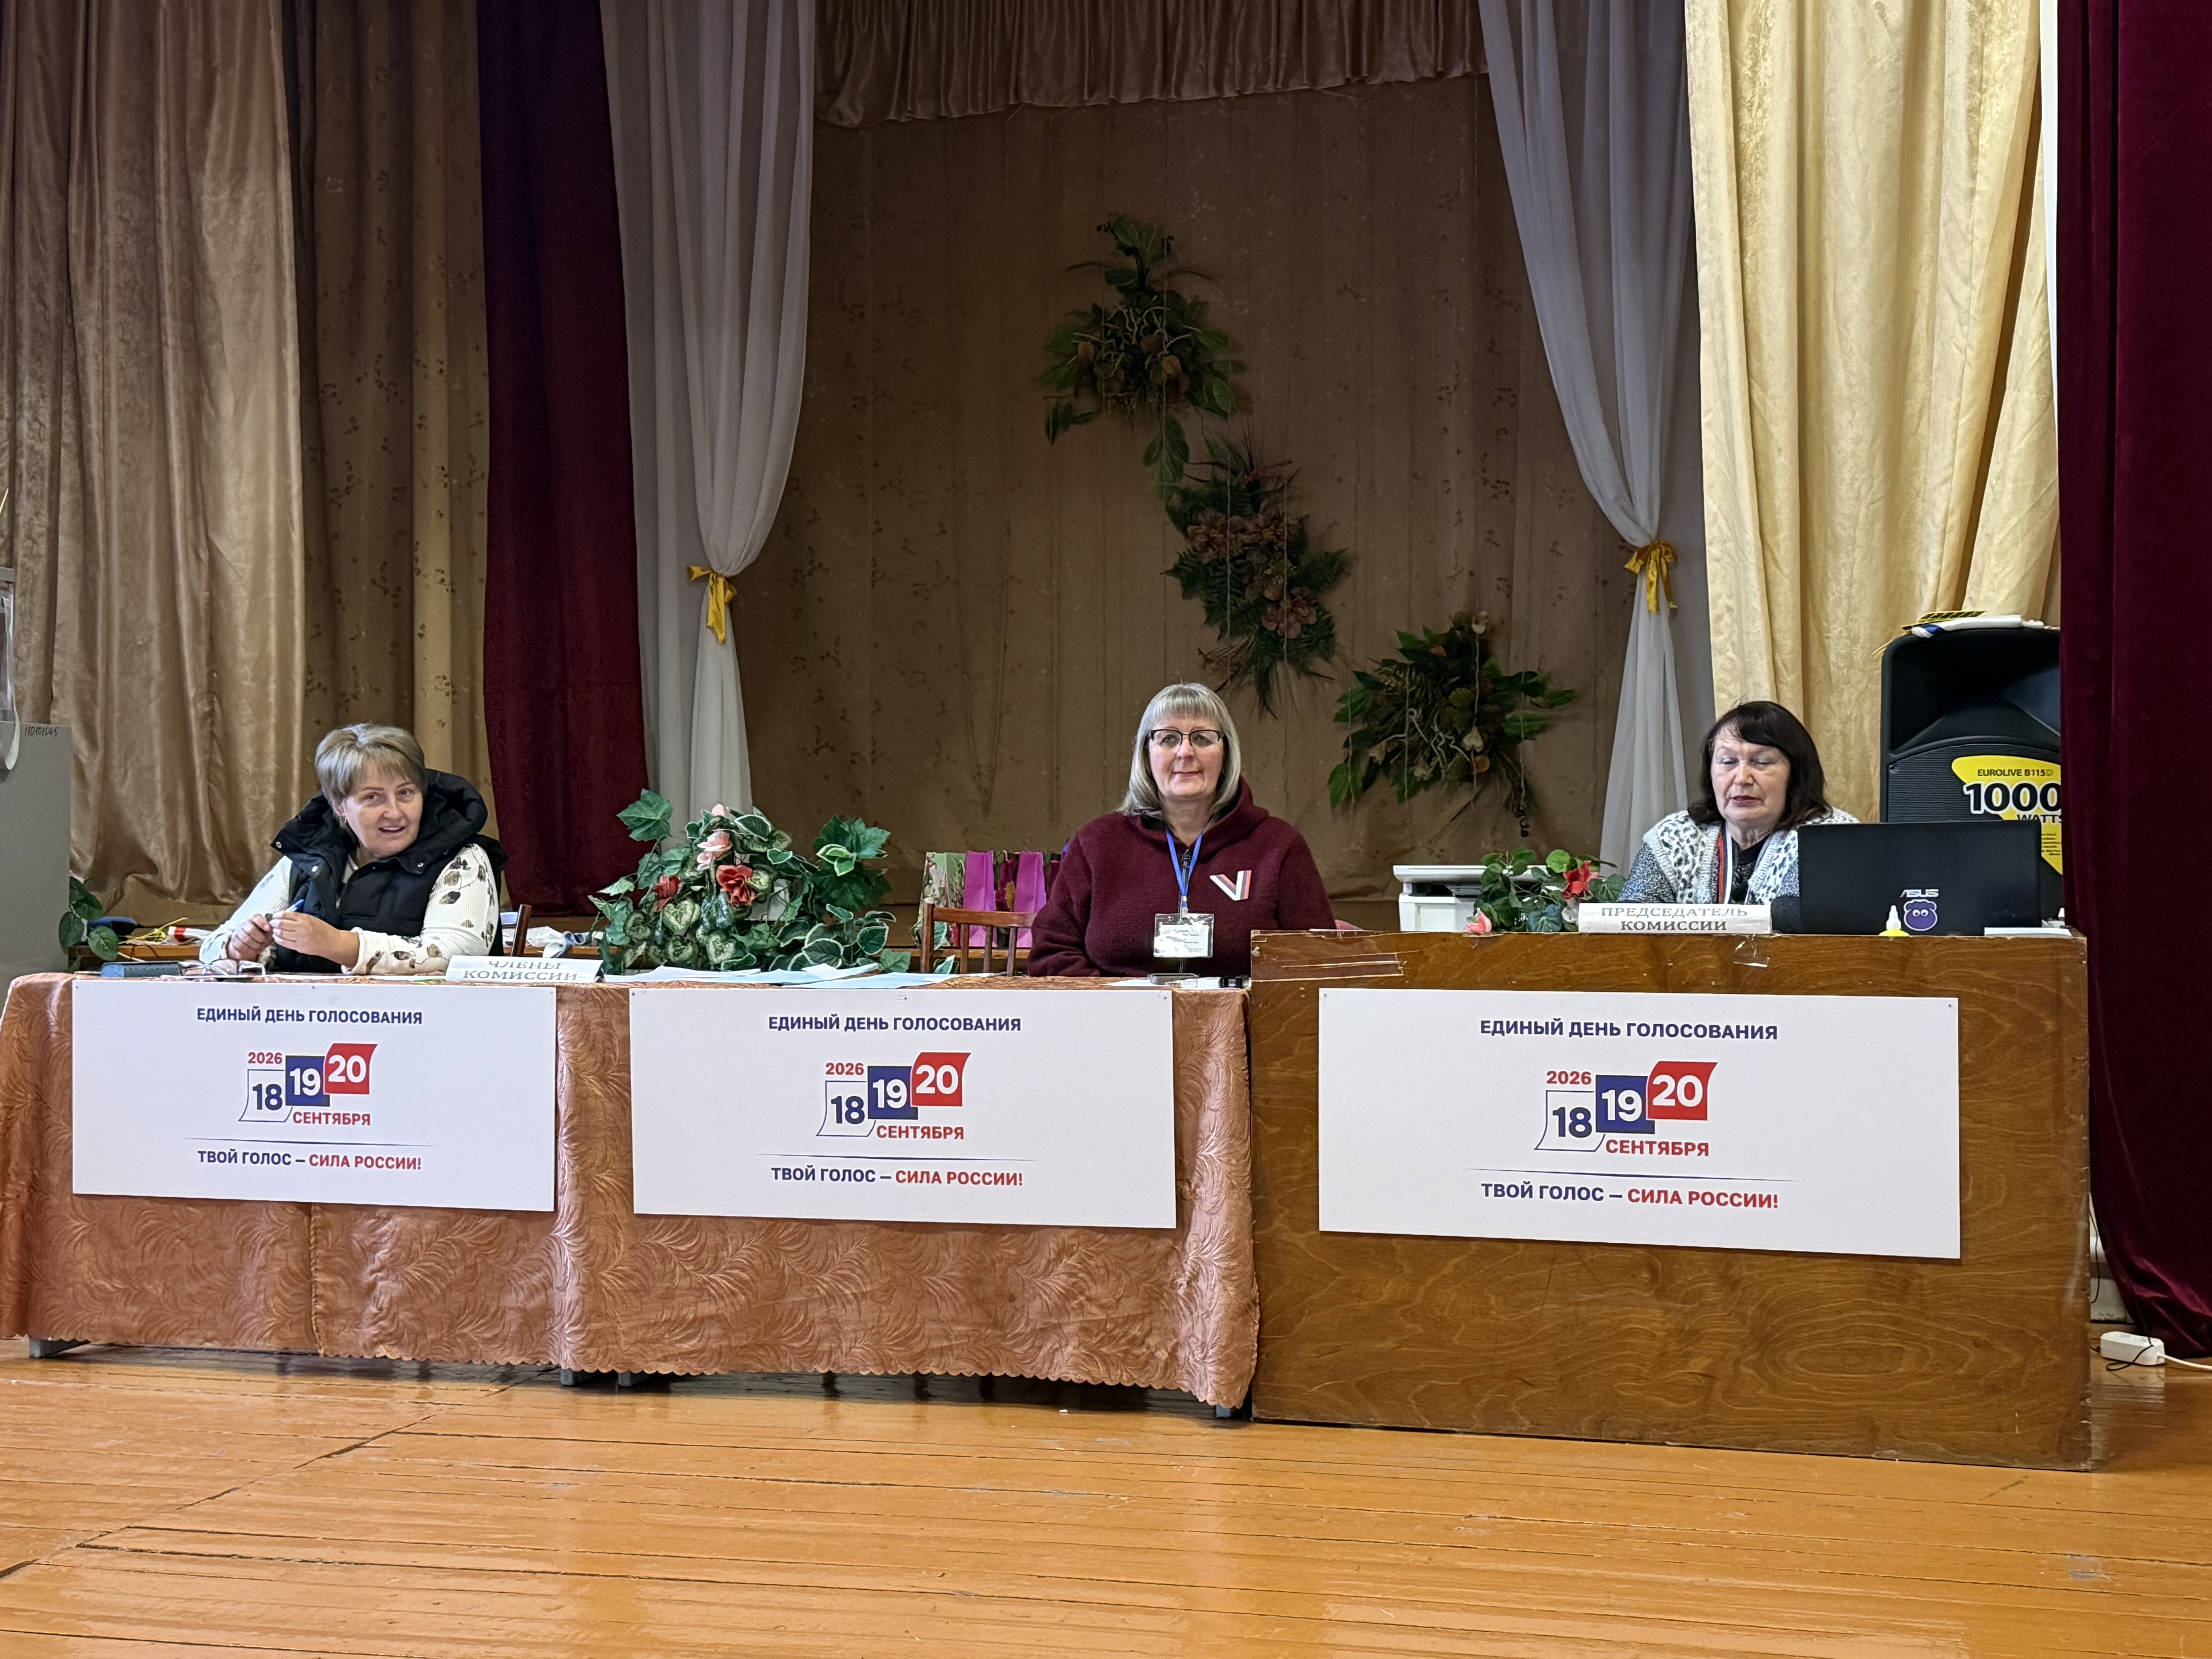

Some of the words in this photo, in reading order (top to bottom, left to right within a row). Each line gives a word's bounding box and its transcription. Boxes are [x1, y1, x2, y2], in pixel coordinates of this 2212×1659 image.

[1965, 782, 2061, 812] 1000
[1899, 888, 1939, 898] ASUS
[1601, 907, 1748, 918] ПРЕДСЕДАТЕЛЬ
[1620, 921, 1728, 931] КОМИССИИ
[489, 960, 562, 969] ЧЛЕНЫ
[463, 970, 578, 981] КОМИССИИ
[198, 1006, 261, 1022] ЕДИНЫЙ
[265, 1009, 304, 1024] ДЕНЬ
[309, 1010, 422, 1025] ГОЛОСОВАНИЯ
[769, 1013, 839, 1031] ЕДИНЫЙ
[844, 1017, 888, 1032] ДЕНЬ
[894, 1017, 1021, 1032] ГОЛОСОВАНИЯ
[1481, 1018, 1563, 1037] ЕДИНЫЙ
[1569, 1022, 1621, 1038] ДЕНЬ
[1627, 1023, 1778, 1040] ГОЛОСОВАНИЯ
[248, 1052, 282, 1065] 2026
[826, 1063, 864, 1075] 2026
[1546, 1070, 1592, 1085] 2026
[253, 1084, 282, 1111] 18
[290, 1068, 321, 1096] 19
[328, 1055, 366, 1083] 20
[831, 1096, 865, 1125] 18
[873, 1079, 907, 1108] 19
[915, 1064, 958, 1094] 20
[1553, 1107, 1592, 1138] 18
[1602, 1089, 1642, 1122] 19
[1652, 1074, 1703, 1107] 20
[293, 1111, 371, 1126] СЕНТЯБРЯ
[876, 1125, 964, 1140] СЕНТЯБРЯ
[1606, 1139, 1709, 1157] СЕНТЯБРЯ
[198, 1149, 237, 1164] ТВОЙ
[242, 1152, 291, 1166] ГОЛОС
[309, 1154, 350, 1167] СИЛА
[355, 1156, 421, 1170] РОССИИ!
[771, 1164, 815, 1181] ТВОЙ
[821, 1169, 875, 1182] ГОЛОС
[896, 1171, 942, 1184] СИЛА
[947, 1172, 1022, 1186] РОССИИ!
[1481, 1181, 1532, 1199] ТВОЙ
[1539, 1185, 1604, 1201] ГОЛОС
[1628, 1189, 1683, 1204] СИЛА
[1689, 1190, 1779, 1209] РОССИИ!
